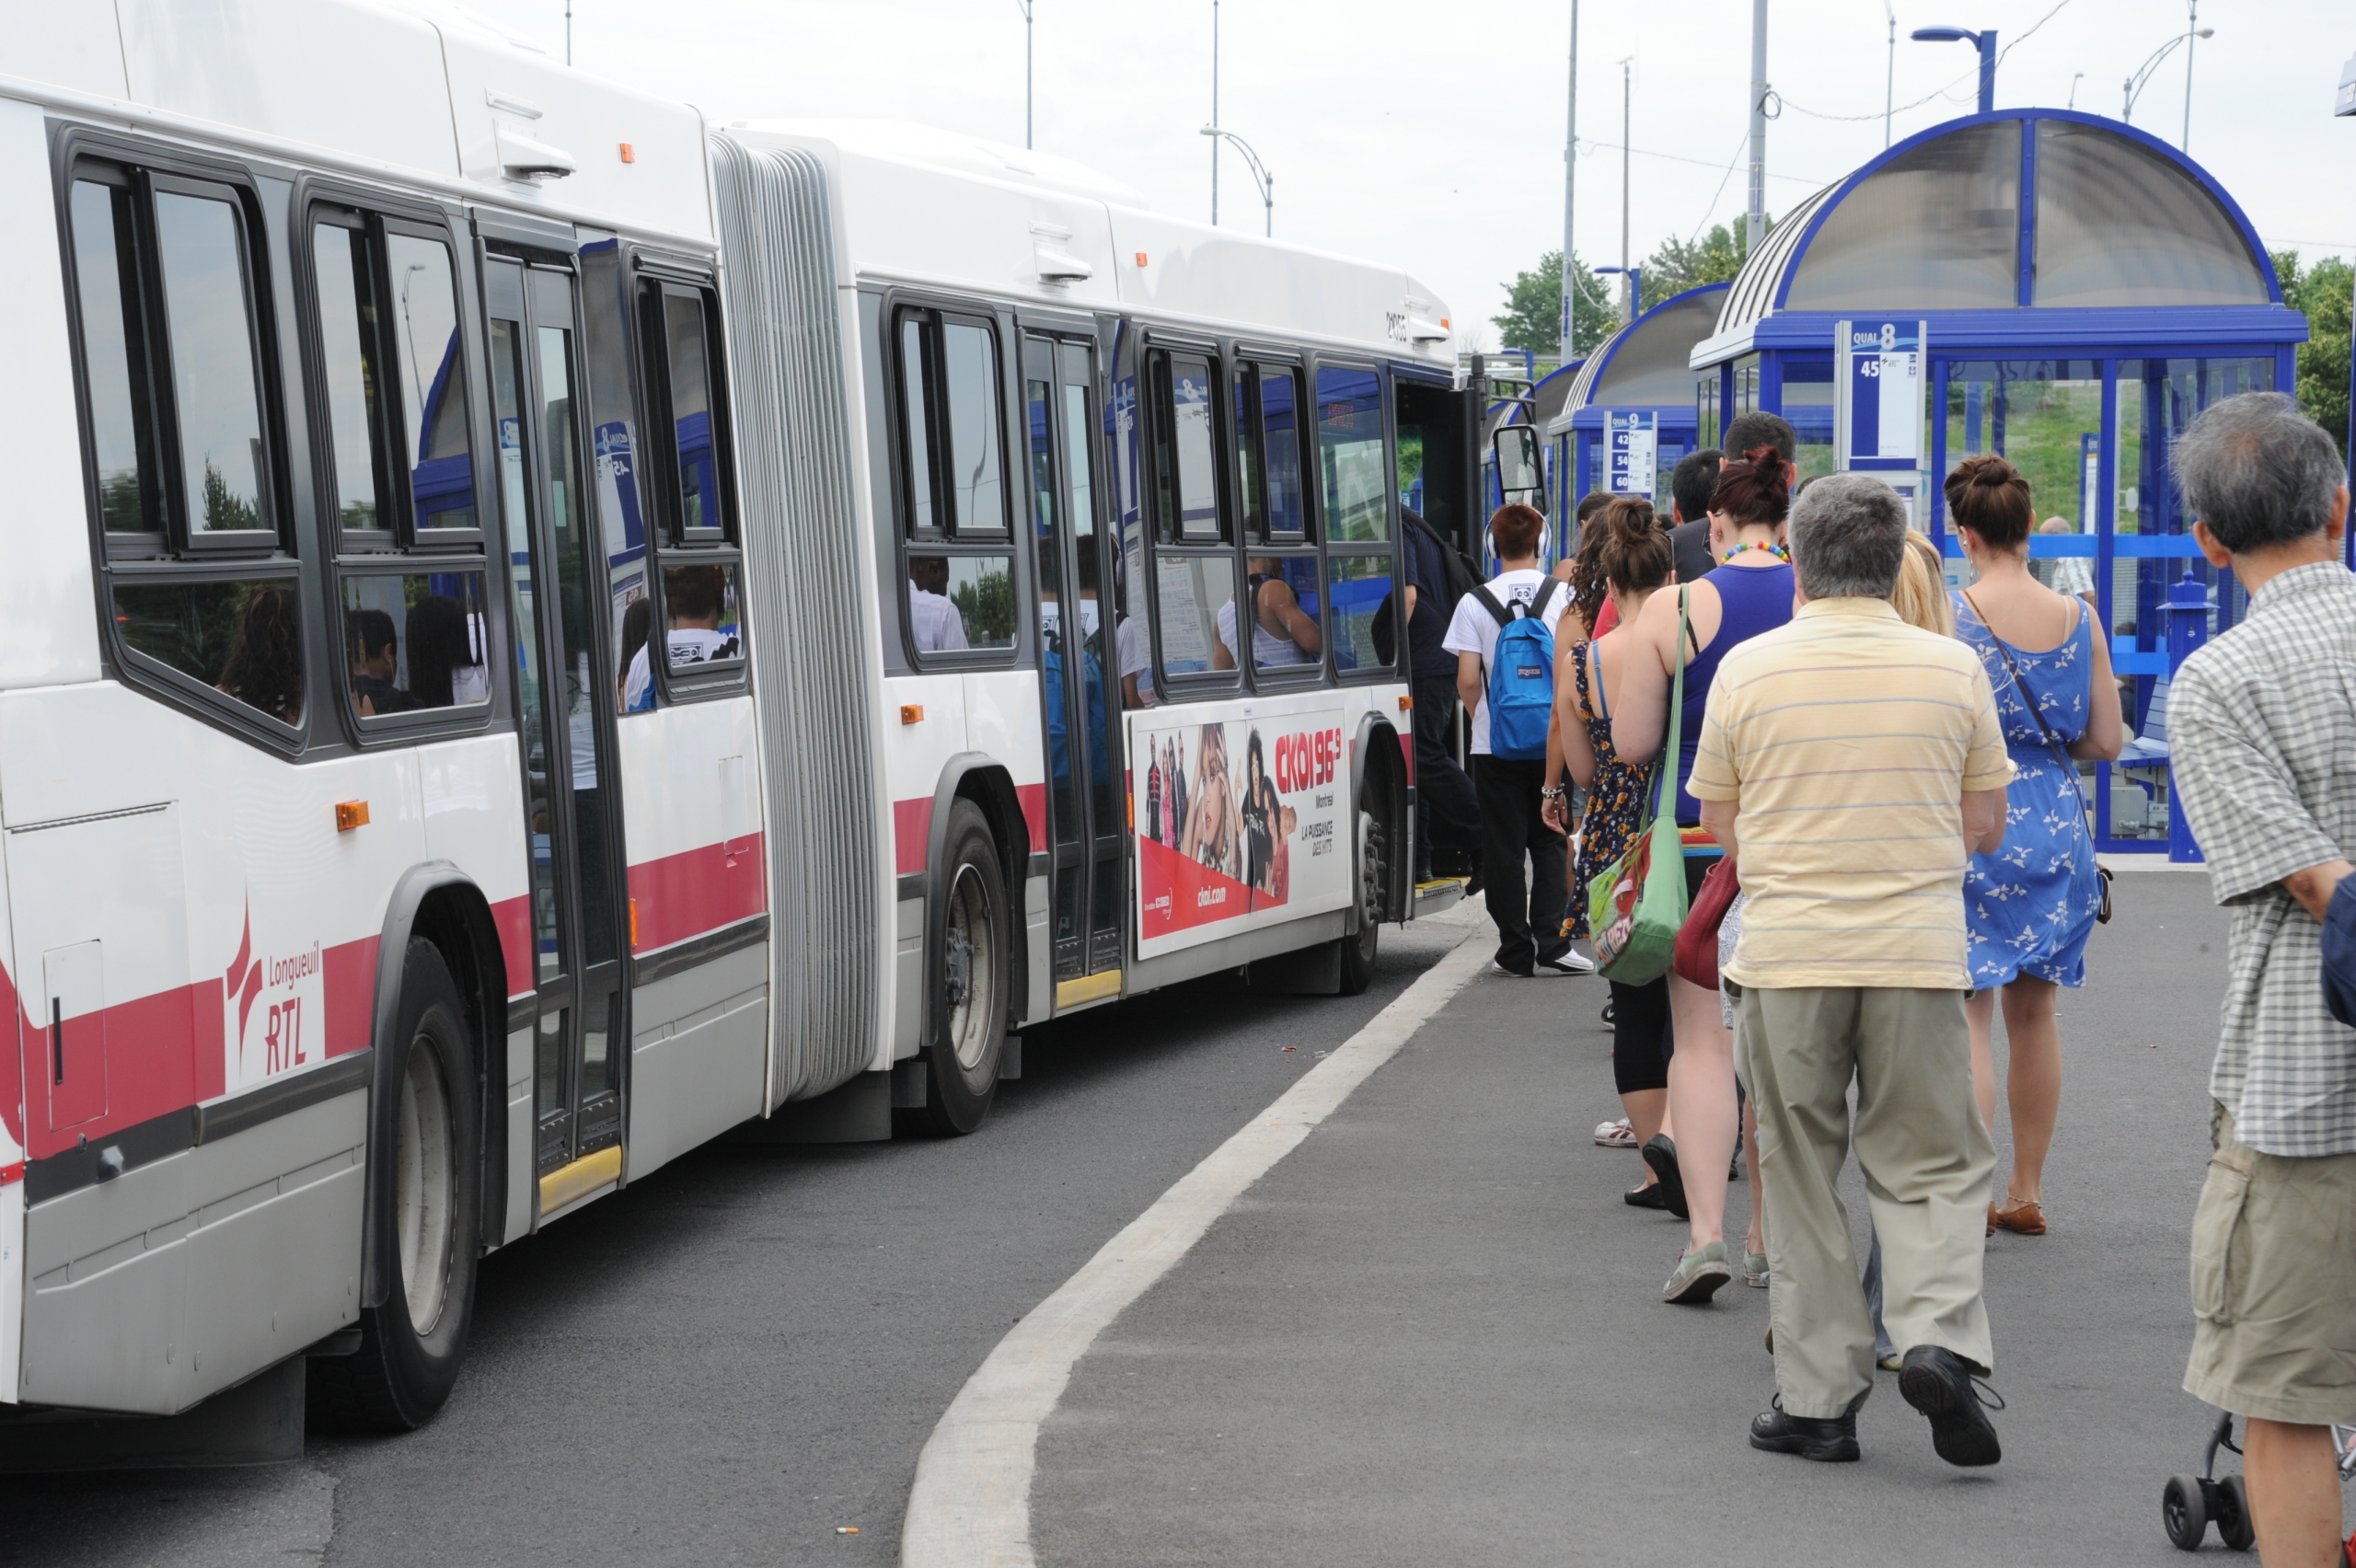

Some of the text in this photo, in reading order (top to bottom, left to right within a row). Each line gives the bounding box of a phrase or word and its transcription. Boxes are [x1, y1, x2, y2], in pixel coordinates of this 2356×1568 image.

[1854, 323, 1896, 350] QUAI 8
[1861, 361, 1879, 377] 45
[1629, 413, 1639, 430] 9
[1617, 434, 1629, 444] 42
[1617, 455, 1628, 466] 54
[1616, 477, 1628, 487] 60
[1301, 820, 1333, 841] LA PUISSANCE
[1312, 838, 1332, 857] DES HITS
[1197, 885, 1226, 907] ckoi.com
[269, 940, 319, 991] Longueuil
[264, 997, 306, 1077] RTL
